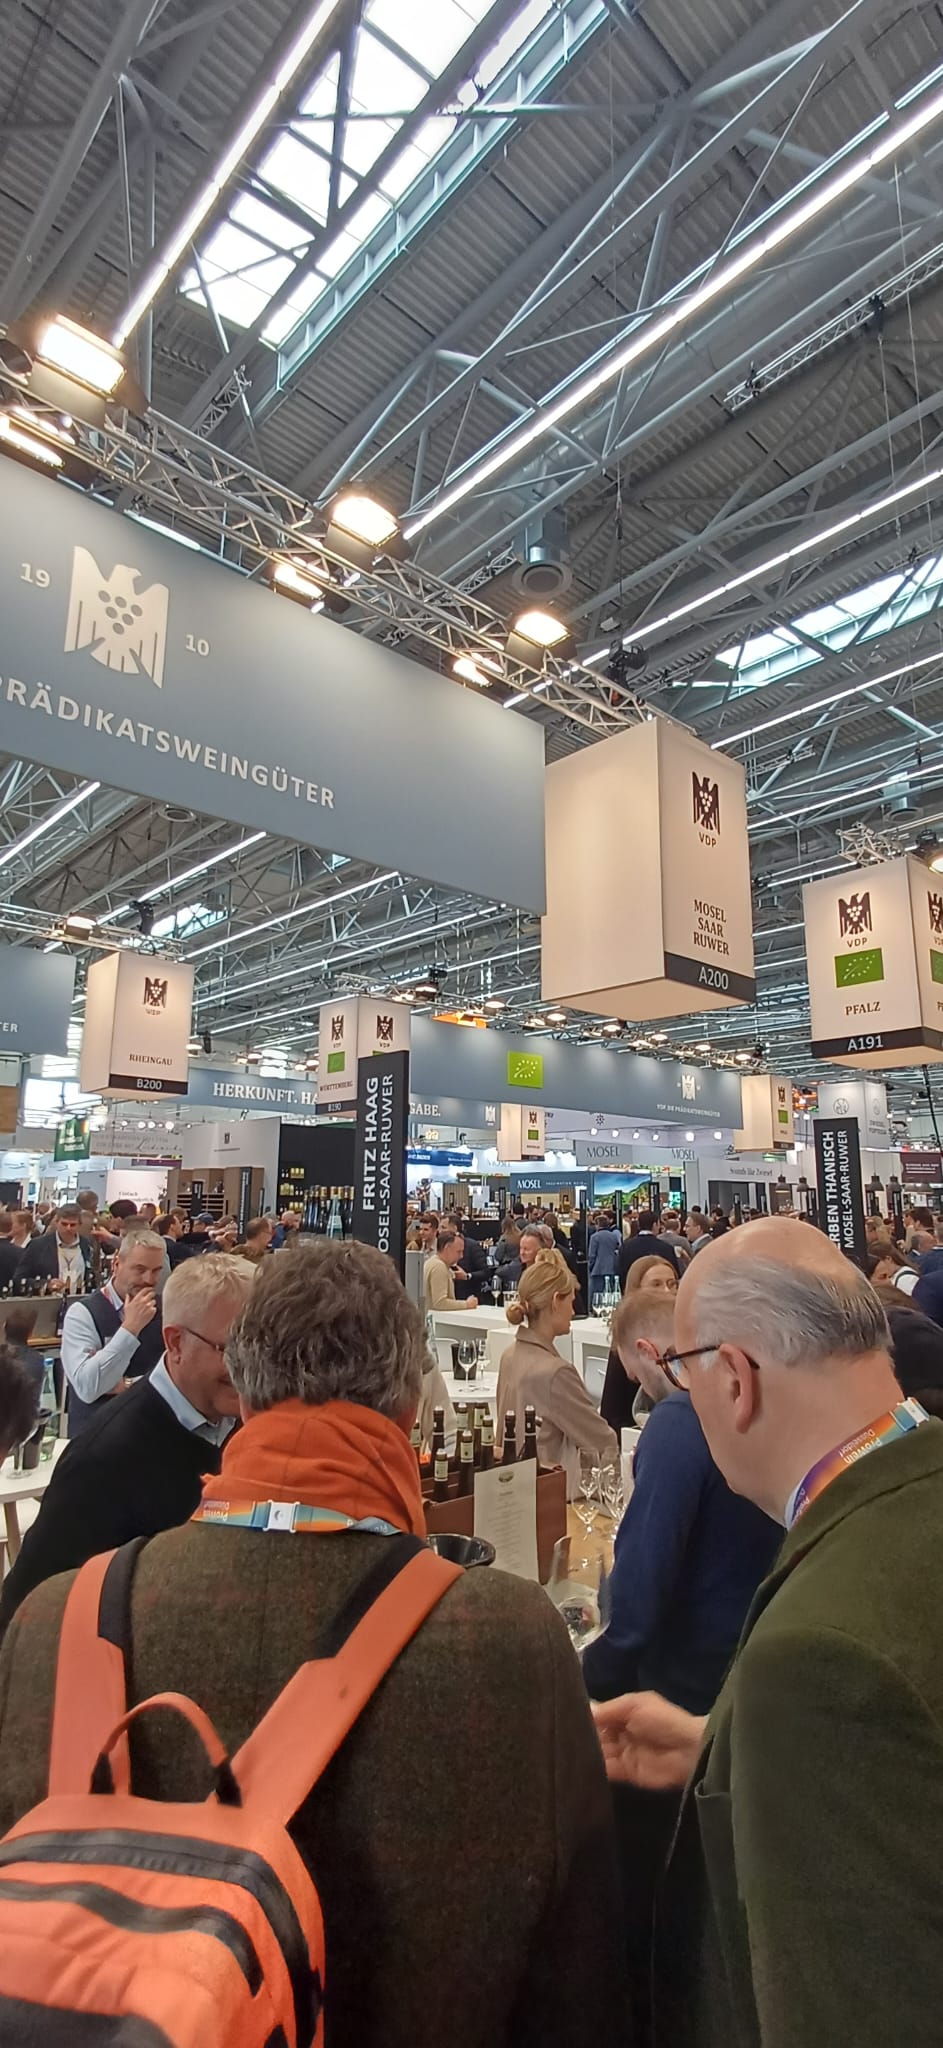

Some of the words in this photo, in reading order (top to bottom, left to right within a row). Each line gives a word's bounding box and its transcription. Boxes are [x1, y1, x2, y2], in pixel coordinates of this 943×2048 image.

[20, 562, 51, 589] 19
[185, 633, 211, 658] 10
[0, 676, 336, 810] RÄDIKATSWEINGÜTER
[698, 832, 717, 848] VDP
[694, 899, 727, 923] MOSEL
[697, 917, 724, 938] SAAR
[693, 931, 730, 956] RUWER
[846, 937, 868, 948] VDP
[698, 966, 729, 990] A200
[845, 1001, 881, 1016] PFALZ
[847, 1035, 884, 1051] A191
[129, 1053, 173, 1066] RHEINGAU
[136, 1078, 163, 1090] B200
[213, 1082, 298, 1104] HERKUNFT.
[364, 1077, 378, 1142] HAAG
[586, 1145, 620, 1158] MOSEL
[671, 1148, 695, 1160] MOSEL
[378, 1074, 393, 1253] OSEL-SAAR-RUWER
[822, 1131, 837, 1202] THANISCH
[362, 1149, 377, 1211] FRITZ
[517, 1179, 541, 1189] MOSEL
